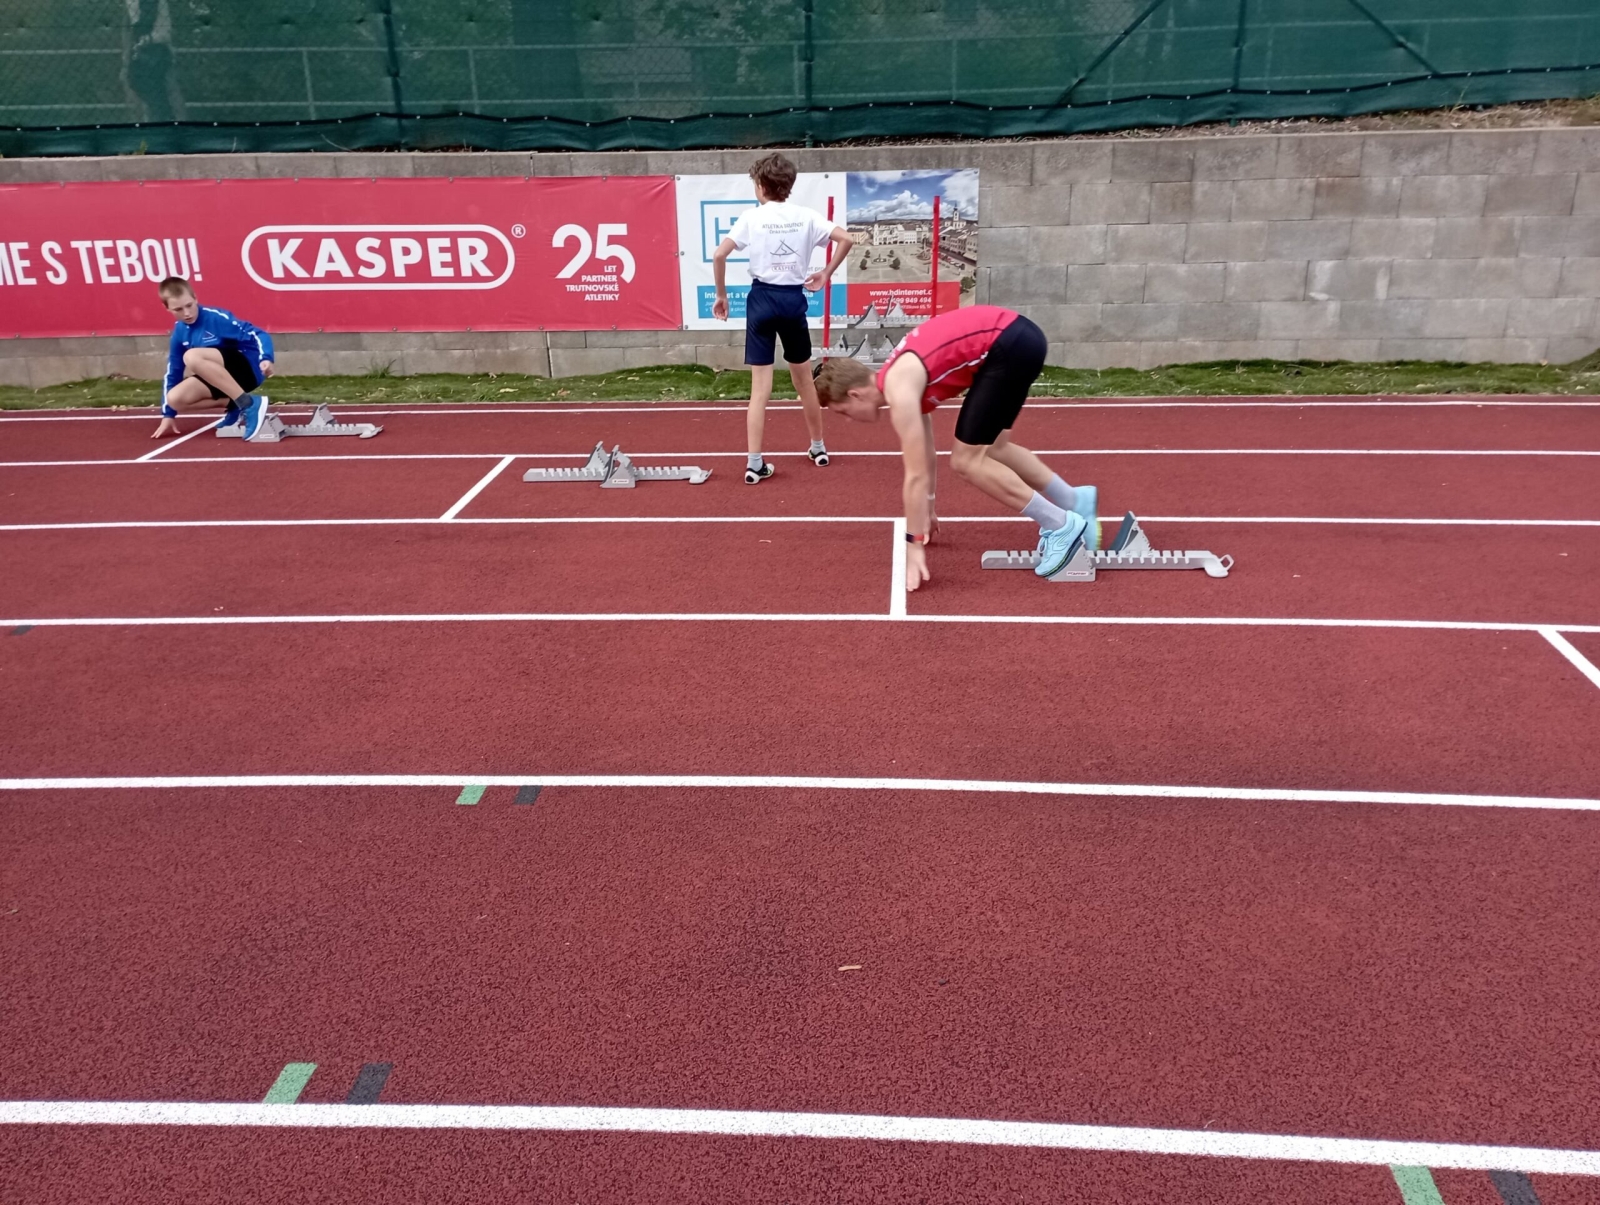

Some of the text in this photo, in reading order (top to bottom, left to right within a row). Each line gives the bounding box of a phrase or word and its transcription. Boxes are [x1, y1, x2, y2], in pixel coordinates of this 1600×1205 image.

[266, 237, 495, 279] KASPER
[551, 222, 636, 284] 25
[40, 240, 68, 285] S
[69, 238, 203, 285] TEBOU!
[603, 265, 617, 273] LET
[581, 274, 618, 282] PARTNER
[565, 282, 619, 292] TRUTNOVSKÉ
[584, 293, 620, 301] ATLETIKY
